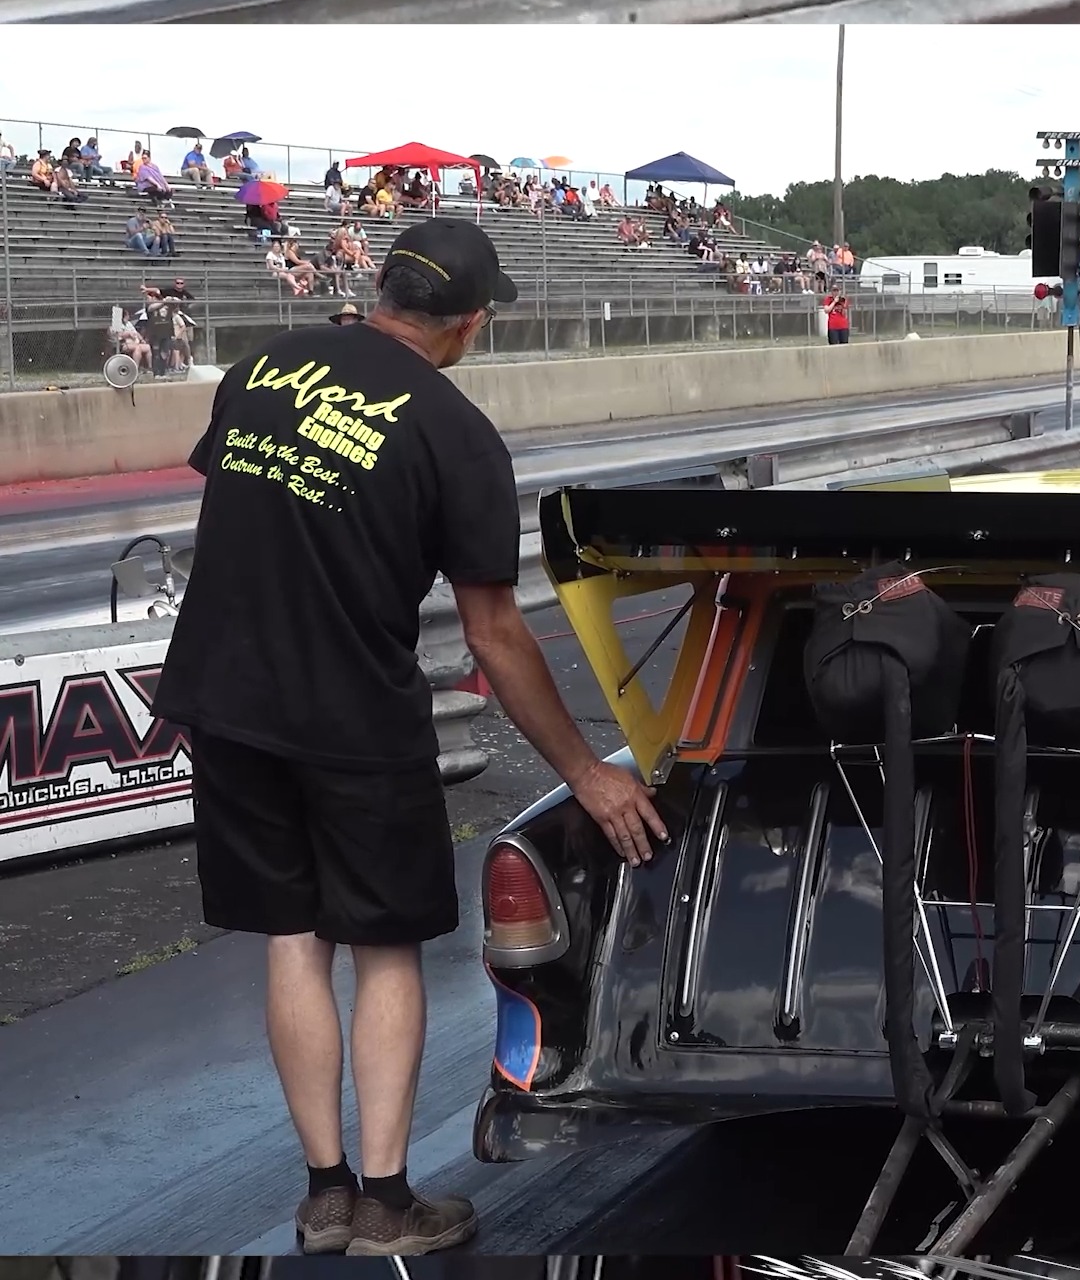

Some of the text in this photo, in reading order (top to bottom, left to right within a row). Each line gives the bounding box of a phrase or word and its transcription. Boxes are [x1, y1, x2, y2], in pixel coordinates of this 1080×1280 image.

[246, 355, 412, 423] Ledford
[226, 428, 258, 449] Built
[258, 435, 277, 458] by
[277, 445, 300, 465] the
[297, 416, 379, 471] Engines
[313, 402, 386, 451] Racing
[221, 452, 263, 476] Outrun
